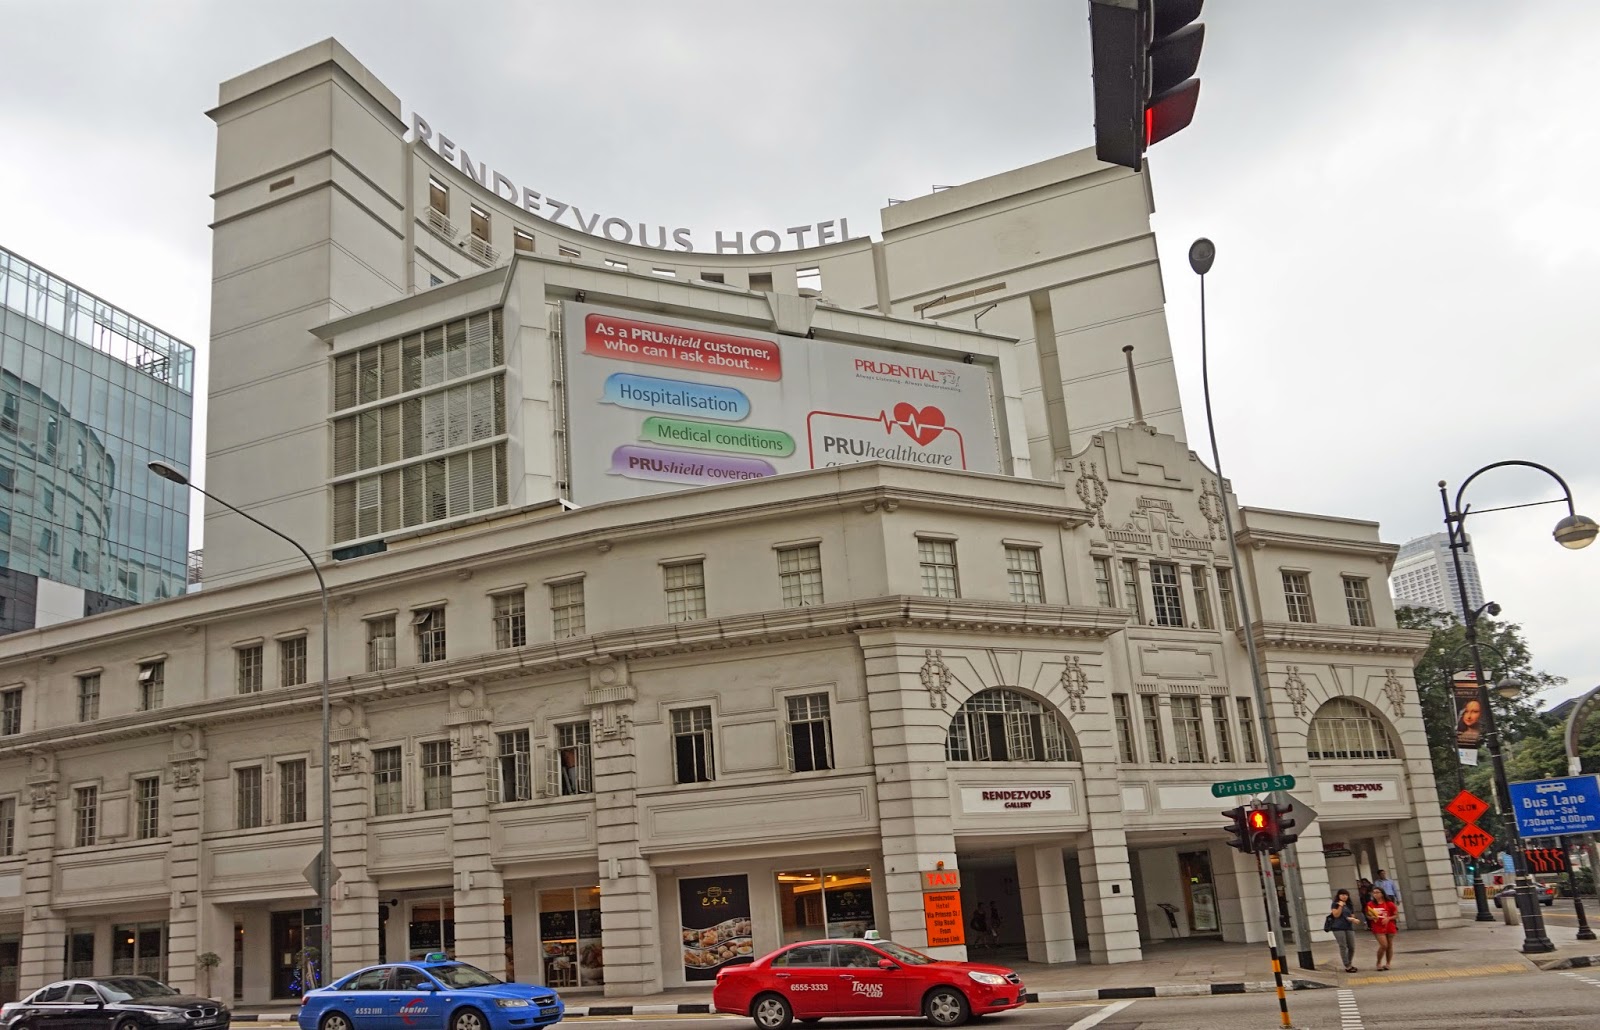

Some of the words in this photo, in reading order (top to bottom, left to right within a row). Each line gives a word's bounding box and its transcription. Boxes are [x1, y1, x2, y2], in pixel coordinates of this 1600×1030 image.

[412, 112, 694, 253] RENDEZVOUS
[715, 218, 860, 254] HOTEL
[595, 322, 615, 337] As
[619, 328, 628, 338] a
[631, 328, 701, 349] PRUshield
[704, 341, 771, 360] customer,
[604, 339, 639, 353] who
[642, 345, 668, 358] can
[680, 350, 704, 363] ask
[854, 359, 939, 382] PRUDENTIAL
[620, 383, 738, 413] Hospitalisation
[658, 424, 711, 443] Medical
[716, 431, 783, 451] conditions
[823, 435, 953, 466] PRUhealthcare
[629, 456, 704, 476] PRUshield
[1218, 780, 1269, 794] Prinsep
[1273, 777, 1288, 788] St
[1333, 783, 1383, 792] RENDEZVOUS
[982, 790, 1052, 801] RENDEZVOUS
[1522, 797, 1548, 809] Bus
[1553, 794, 1586, 806] Lane
[1004, 801, 1032, 809] GALLERY
[1457, 804, 1477, 812] SLOW
[926, 873, 957, 886] TAXI
[790, 983, 828, 991] 6555-3333
[852, 981, 883, 992] TRANS
[866, 990, 883, 998] cab
[400, 1006, 428, 1014] Comfort
